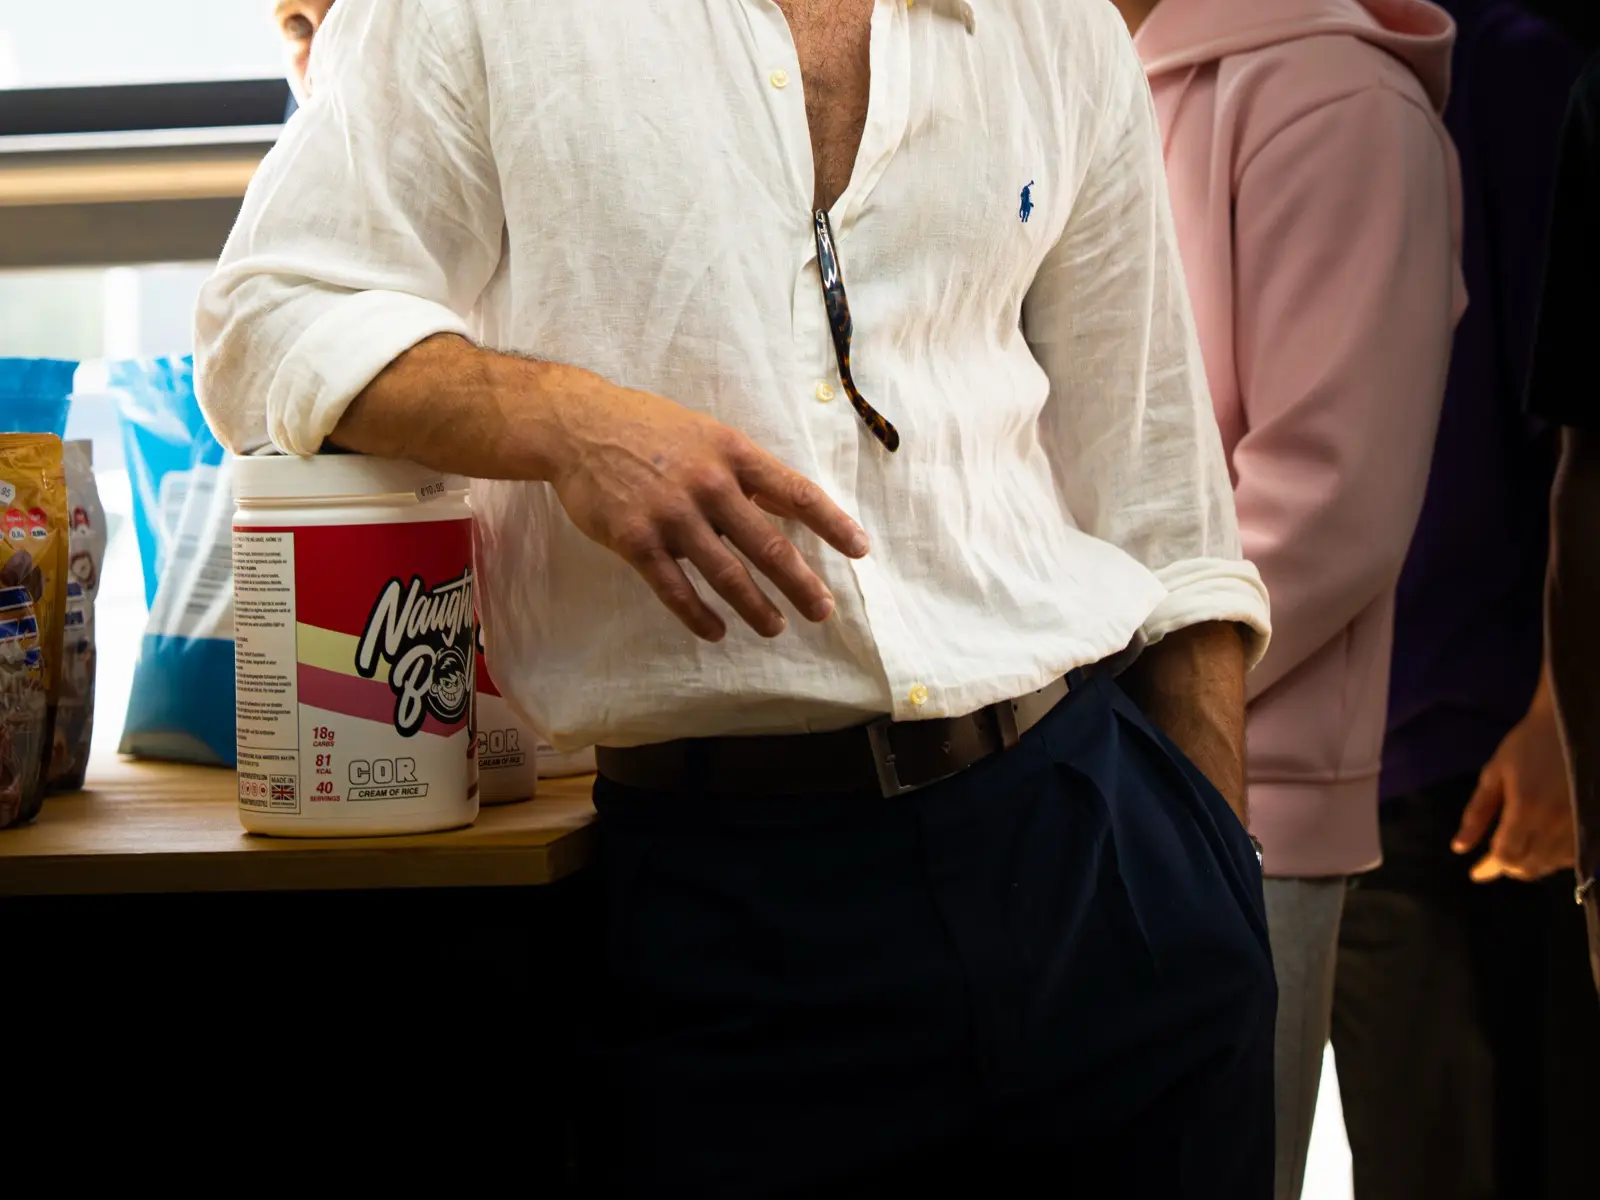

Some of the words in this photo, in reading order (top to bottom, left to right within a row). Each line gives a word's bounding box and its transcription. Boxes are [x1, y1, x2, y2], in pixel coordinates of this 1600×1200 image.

[359, 567, 474, 683] Naught
[312, 726, 335, 740] 18g
[477, 728, 520, 755] COR
[315, 754, 332, 767] 81
[316, 767, 332, 775] KCAL
[349, 757, 418, 786] COR
[316, 780, 334, 794] 40
[358, 788, 387, 798] CREAM
[389, 787, 400, 796] OF
[401, 786, 419, 795] RICE
[310, 795, 340, 803] SERVINGS
